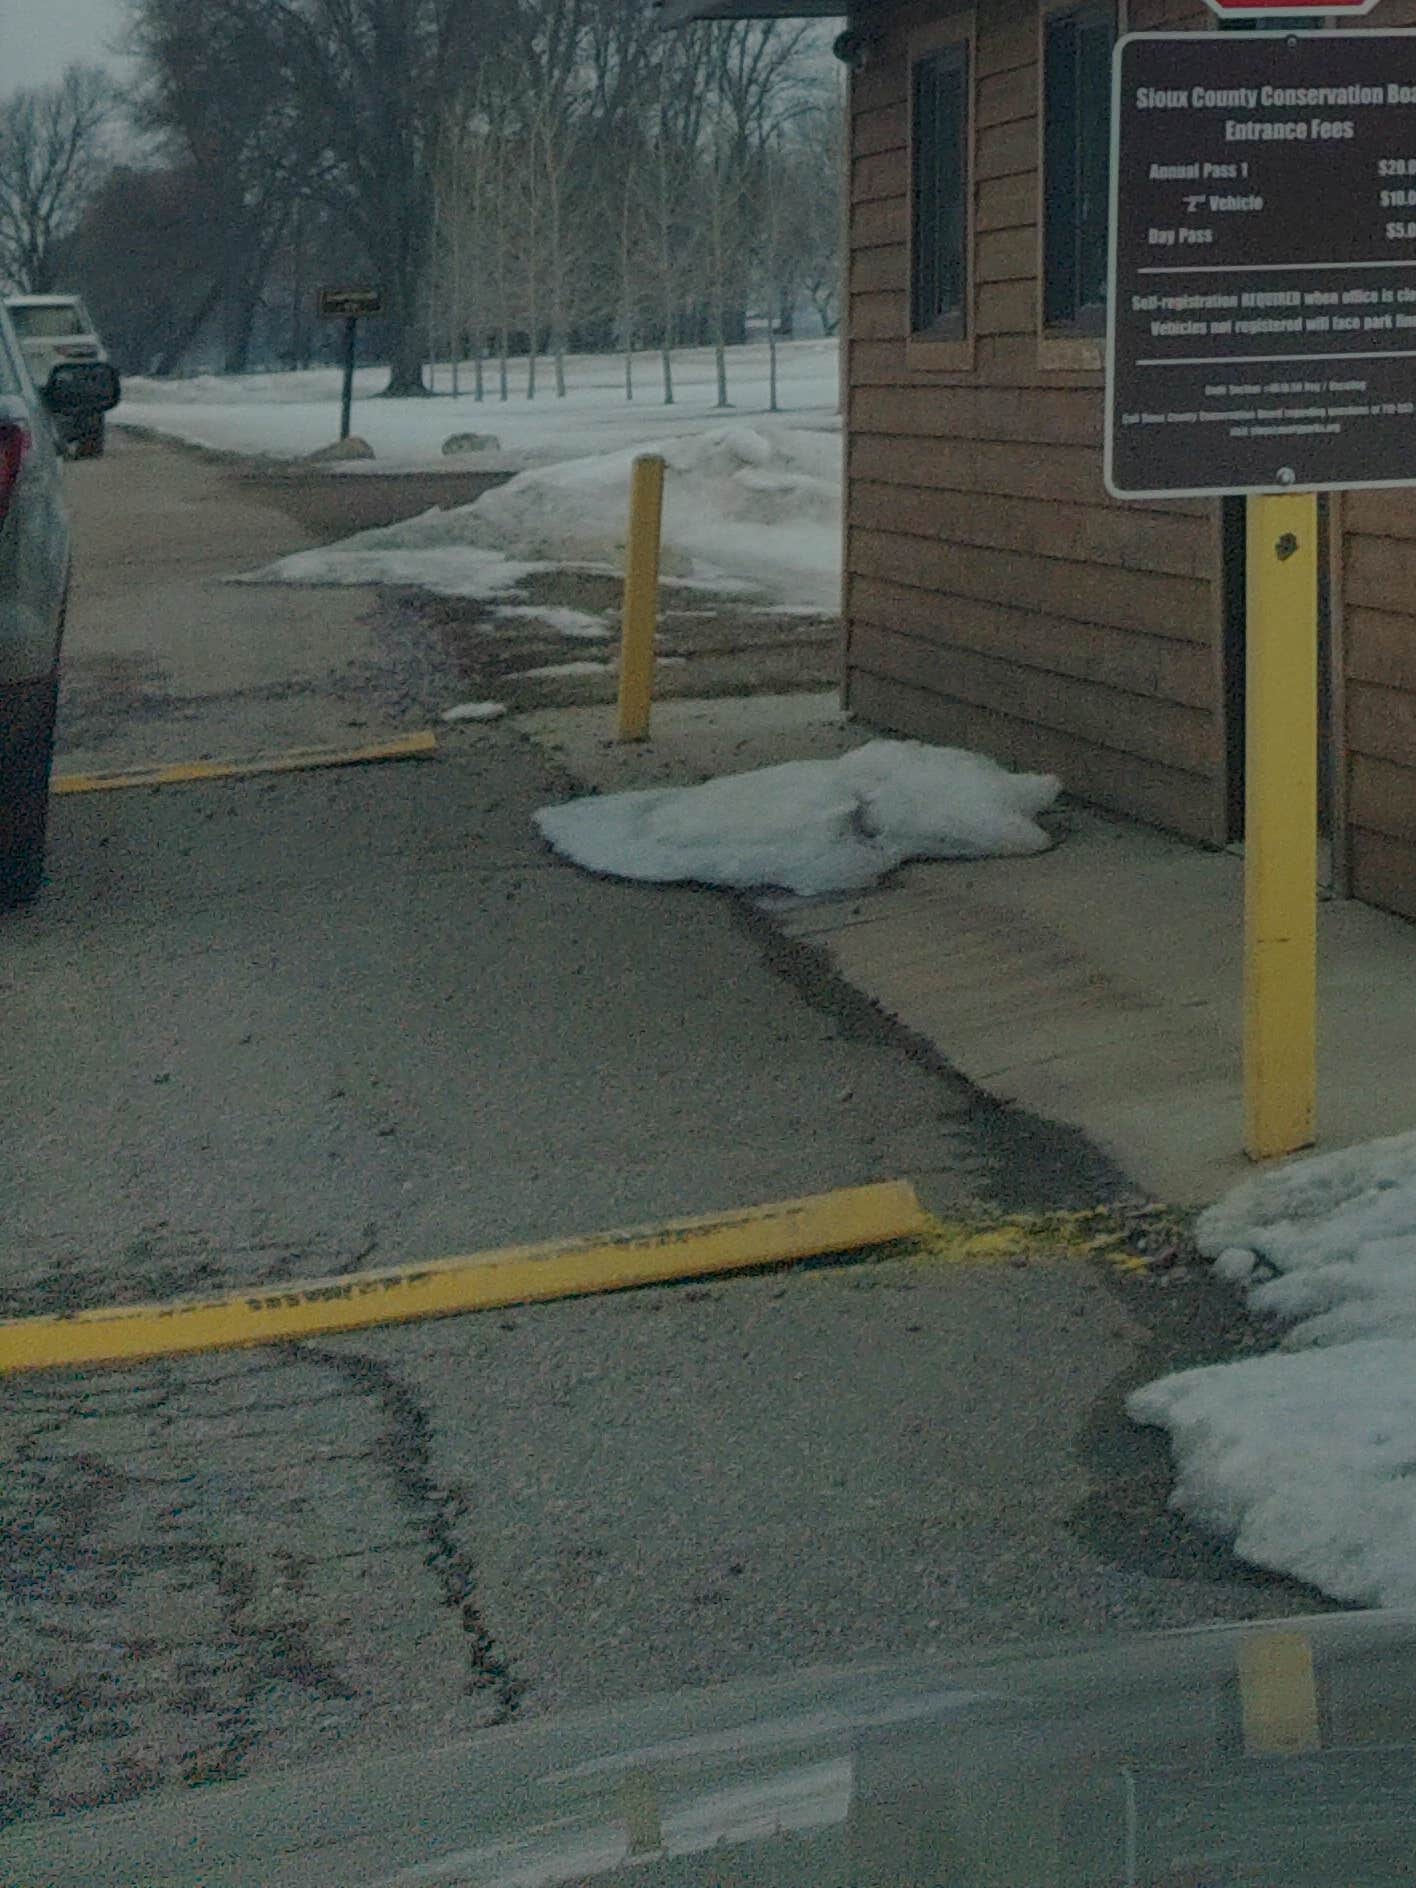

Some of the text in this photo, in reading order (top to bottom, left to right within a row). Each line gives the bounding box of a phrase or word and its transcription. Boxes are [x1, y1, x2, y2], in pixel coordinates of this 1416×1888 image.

[1135, 87, 1189, 109] Sioux
[1191, 86, 1258, 109] County
[1260, 83, 1384, 107] Conservation
[1225, 118, 1354, 141] Entrance Fees
[1148, 162, 1200, 180] Annual
[1202, 162, 1238, 179] Pass
[1209, 194, 1264, 212] Vehicle
[1148, 227, 1176, 246] Day
[1178, 227, 1214, 244] Pass
